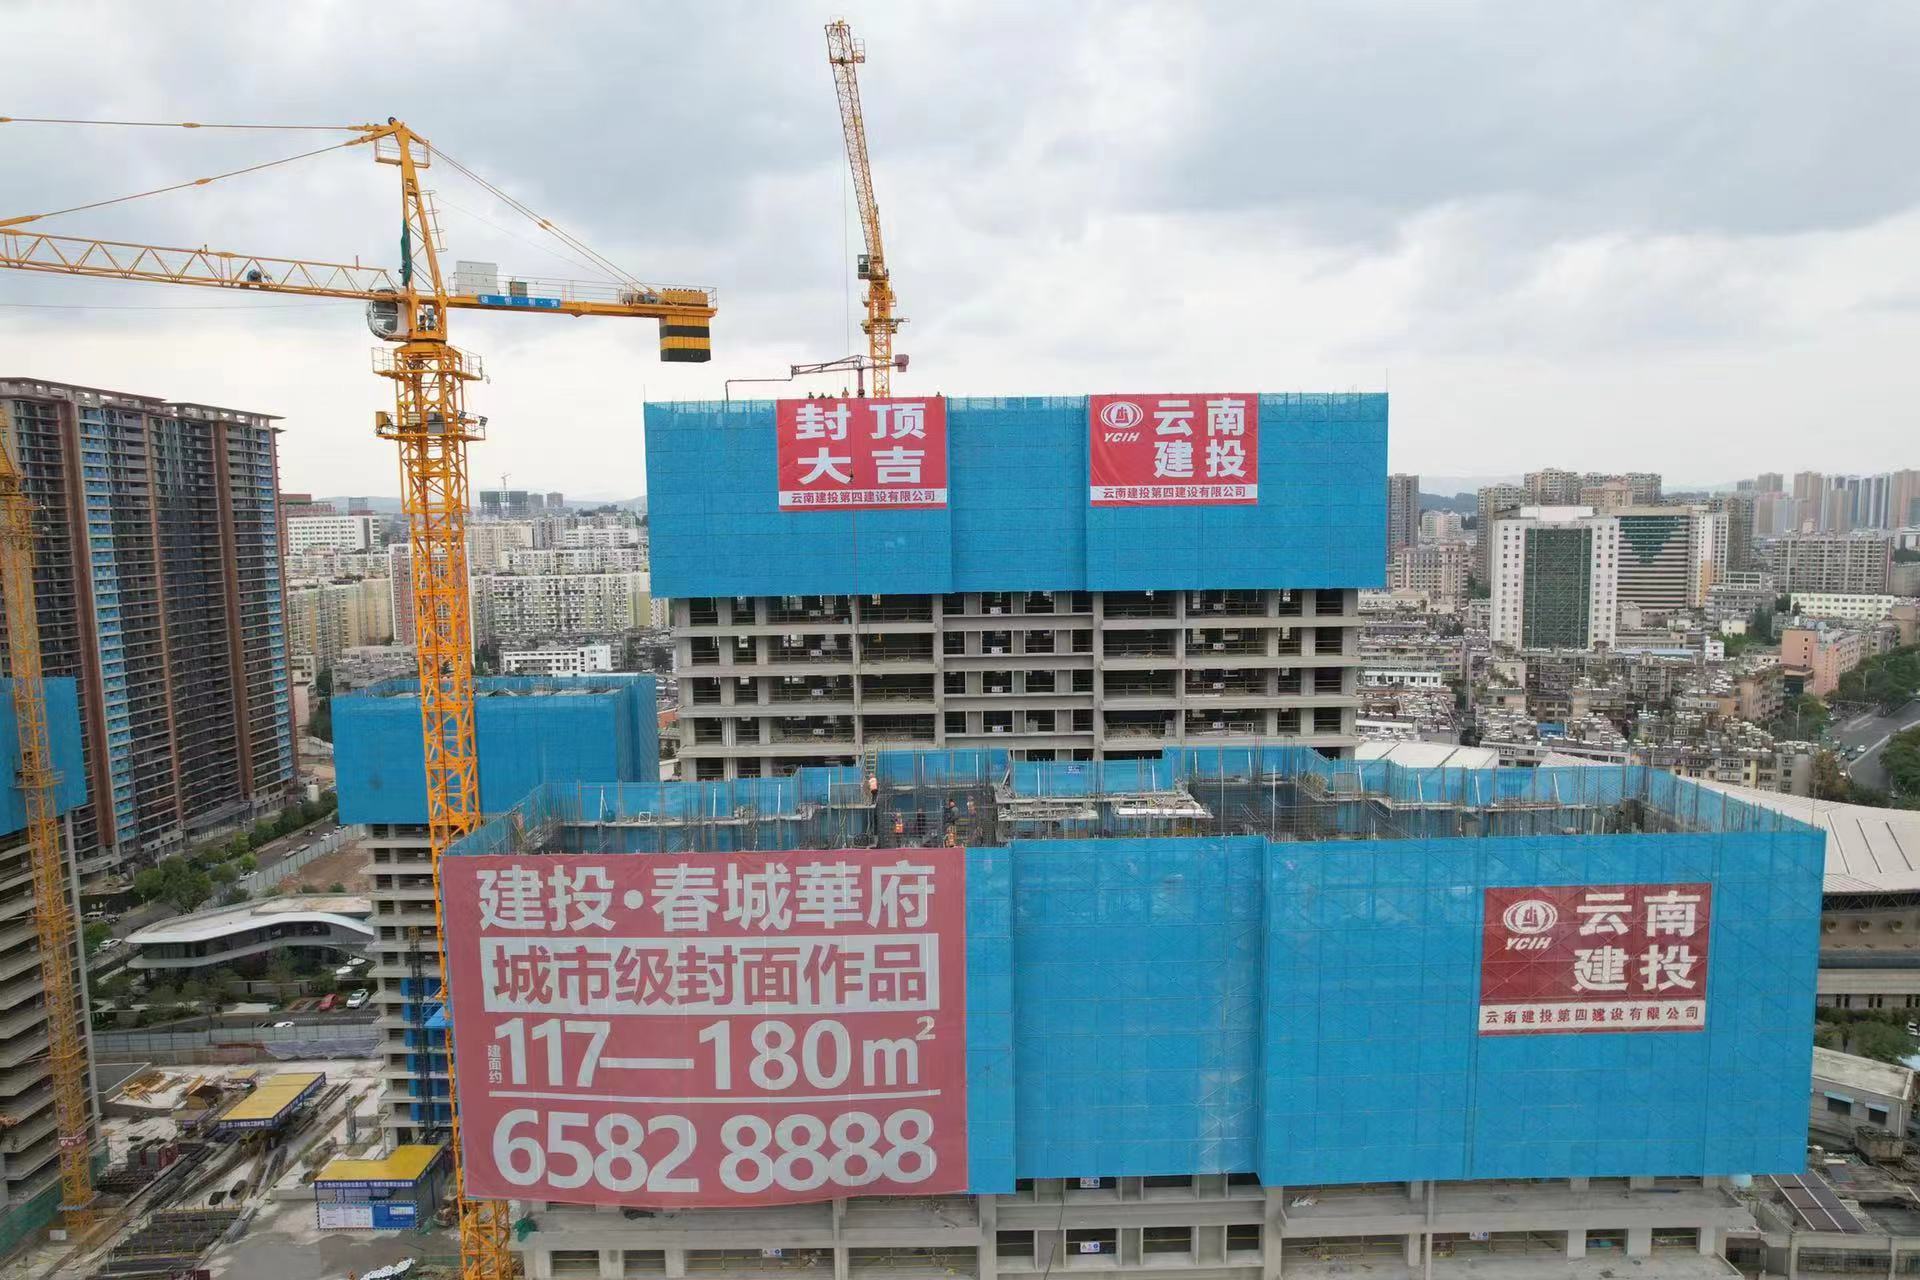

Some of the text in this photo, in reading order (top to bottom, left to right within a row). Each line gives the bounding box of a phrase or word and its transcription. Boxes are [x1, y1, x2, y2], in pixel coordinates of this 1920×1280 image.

[796, 403, 927, 441] 封顶
[1153, 397, 1245, 437] 云南
[1104, 432, 1140, 443] YCIH
[797, 446, 925, 485] 大吉
[1153, 439, 1246, 479] 建投
[791, 490, 936, 504] 云南建投第四建设有限公司
[1103, 486, 1246, 499] 云南建投第四建设有限公司
[476, 860, 936, 932] 建投·春城華府
[1576, 890, 1701, 938] 云南
[1505, 937, 1552, 951] YCIH
[493, 943, 927, 1006] 城市级封面作品
[1571, 944, 1698, 992] 建投
[1485, 1006, 1699, 1025] 云南建投第四建设有限公司
[488, 1044, 502, 1084] 建面约
[492, 1108, 938, 1193] 6582 8888
